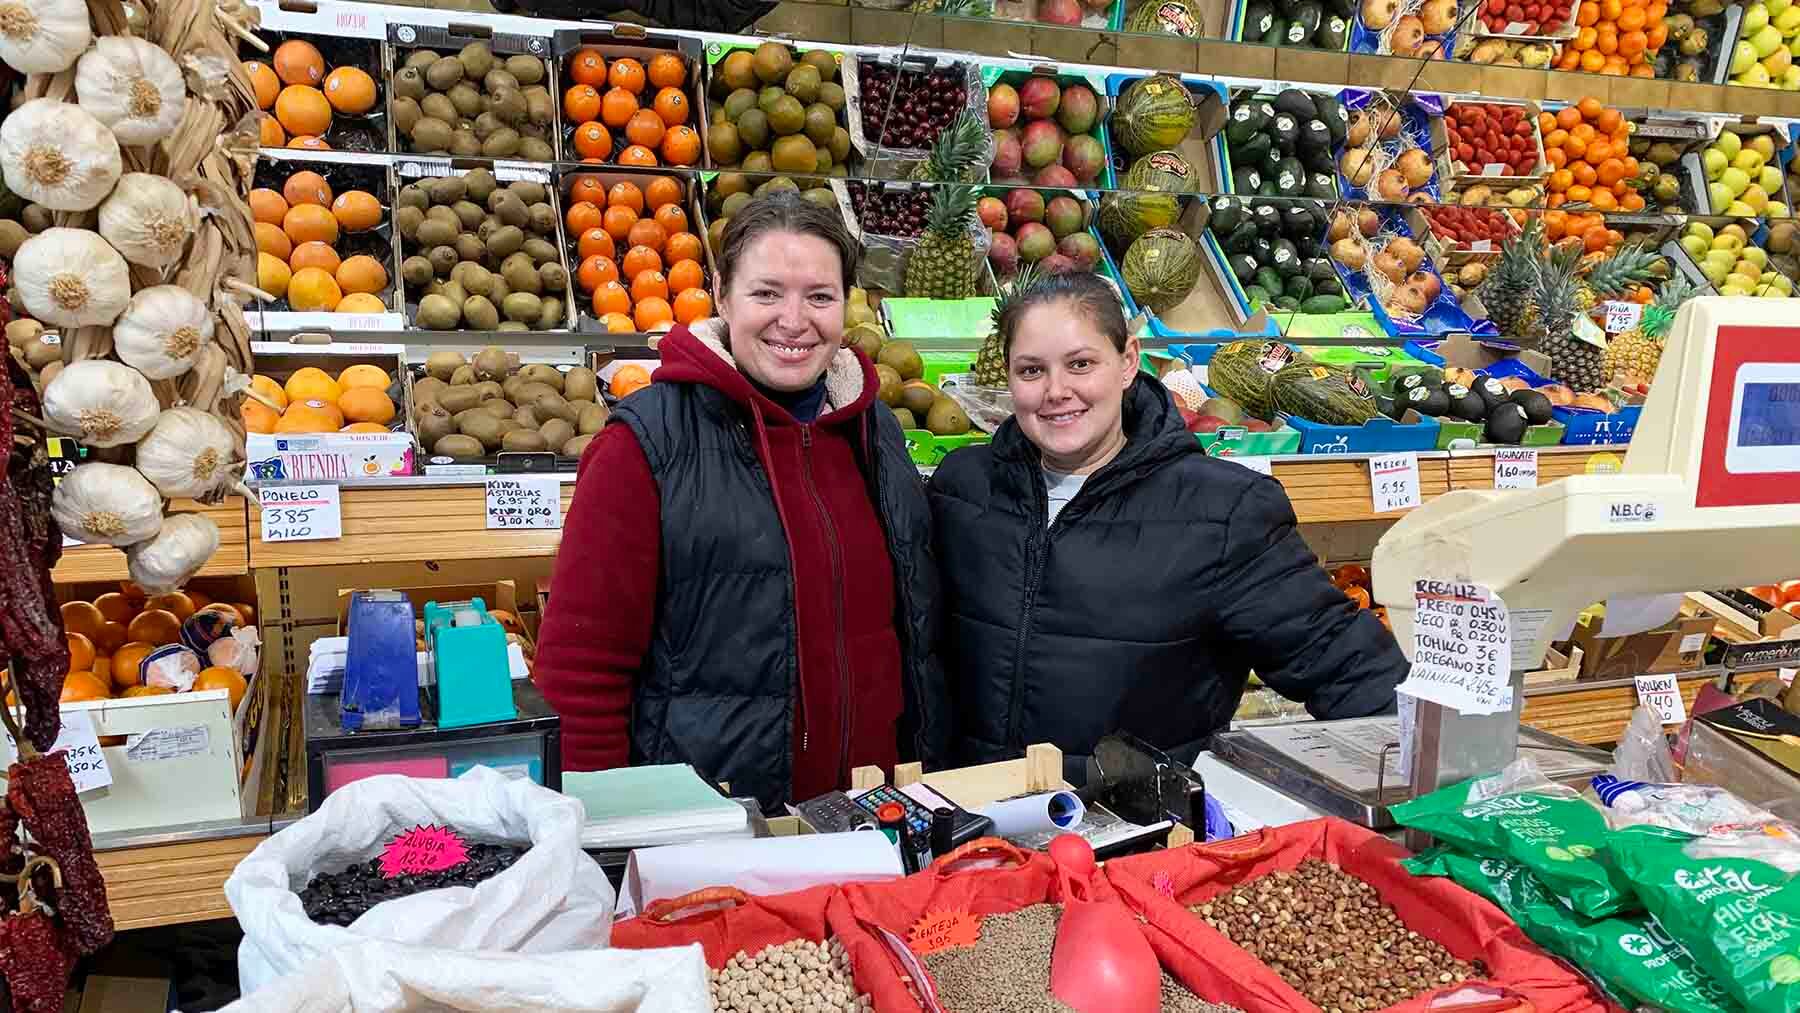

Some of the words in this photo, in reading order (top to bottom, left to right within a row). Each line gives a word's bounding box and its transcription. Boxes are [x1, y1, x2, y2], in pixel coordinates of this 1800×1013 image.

[1496, 450, 1535, 460] AGUACATE
[488, 480, 520, 489] KIWI
[262, 489, 318, 502] POMELO
[487, 489, 541, 497] ASTURIAS
[497, 496, 528, 505] 6.95
[530, 497, 540, 505] K
[527, 507, 552, 516] ORO
[525, 517, 534, 525] K
[1416, 580, 1477, 597] REGALIZ
[1417, 599, 1464, 616] FRESCO
[1414, 611, 1445, 629] SECO
[1468, 631, 1498, 643] 0.20
[1415, 651, 1474, 673] OREGANO
[1637, 679, 1672, 692] GOLDEN
[402, 837, 445, 853] ALUBIA
